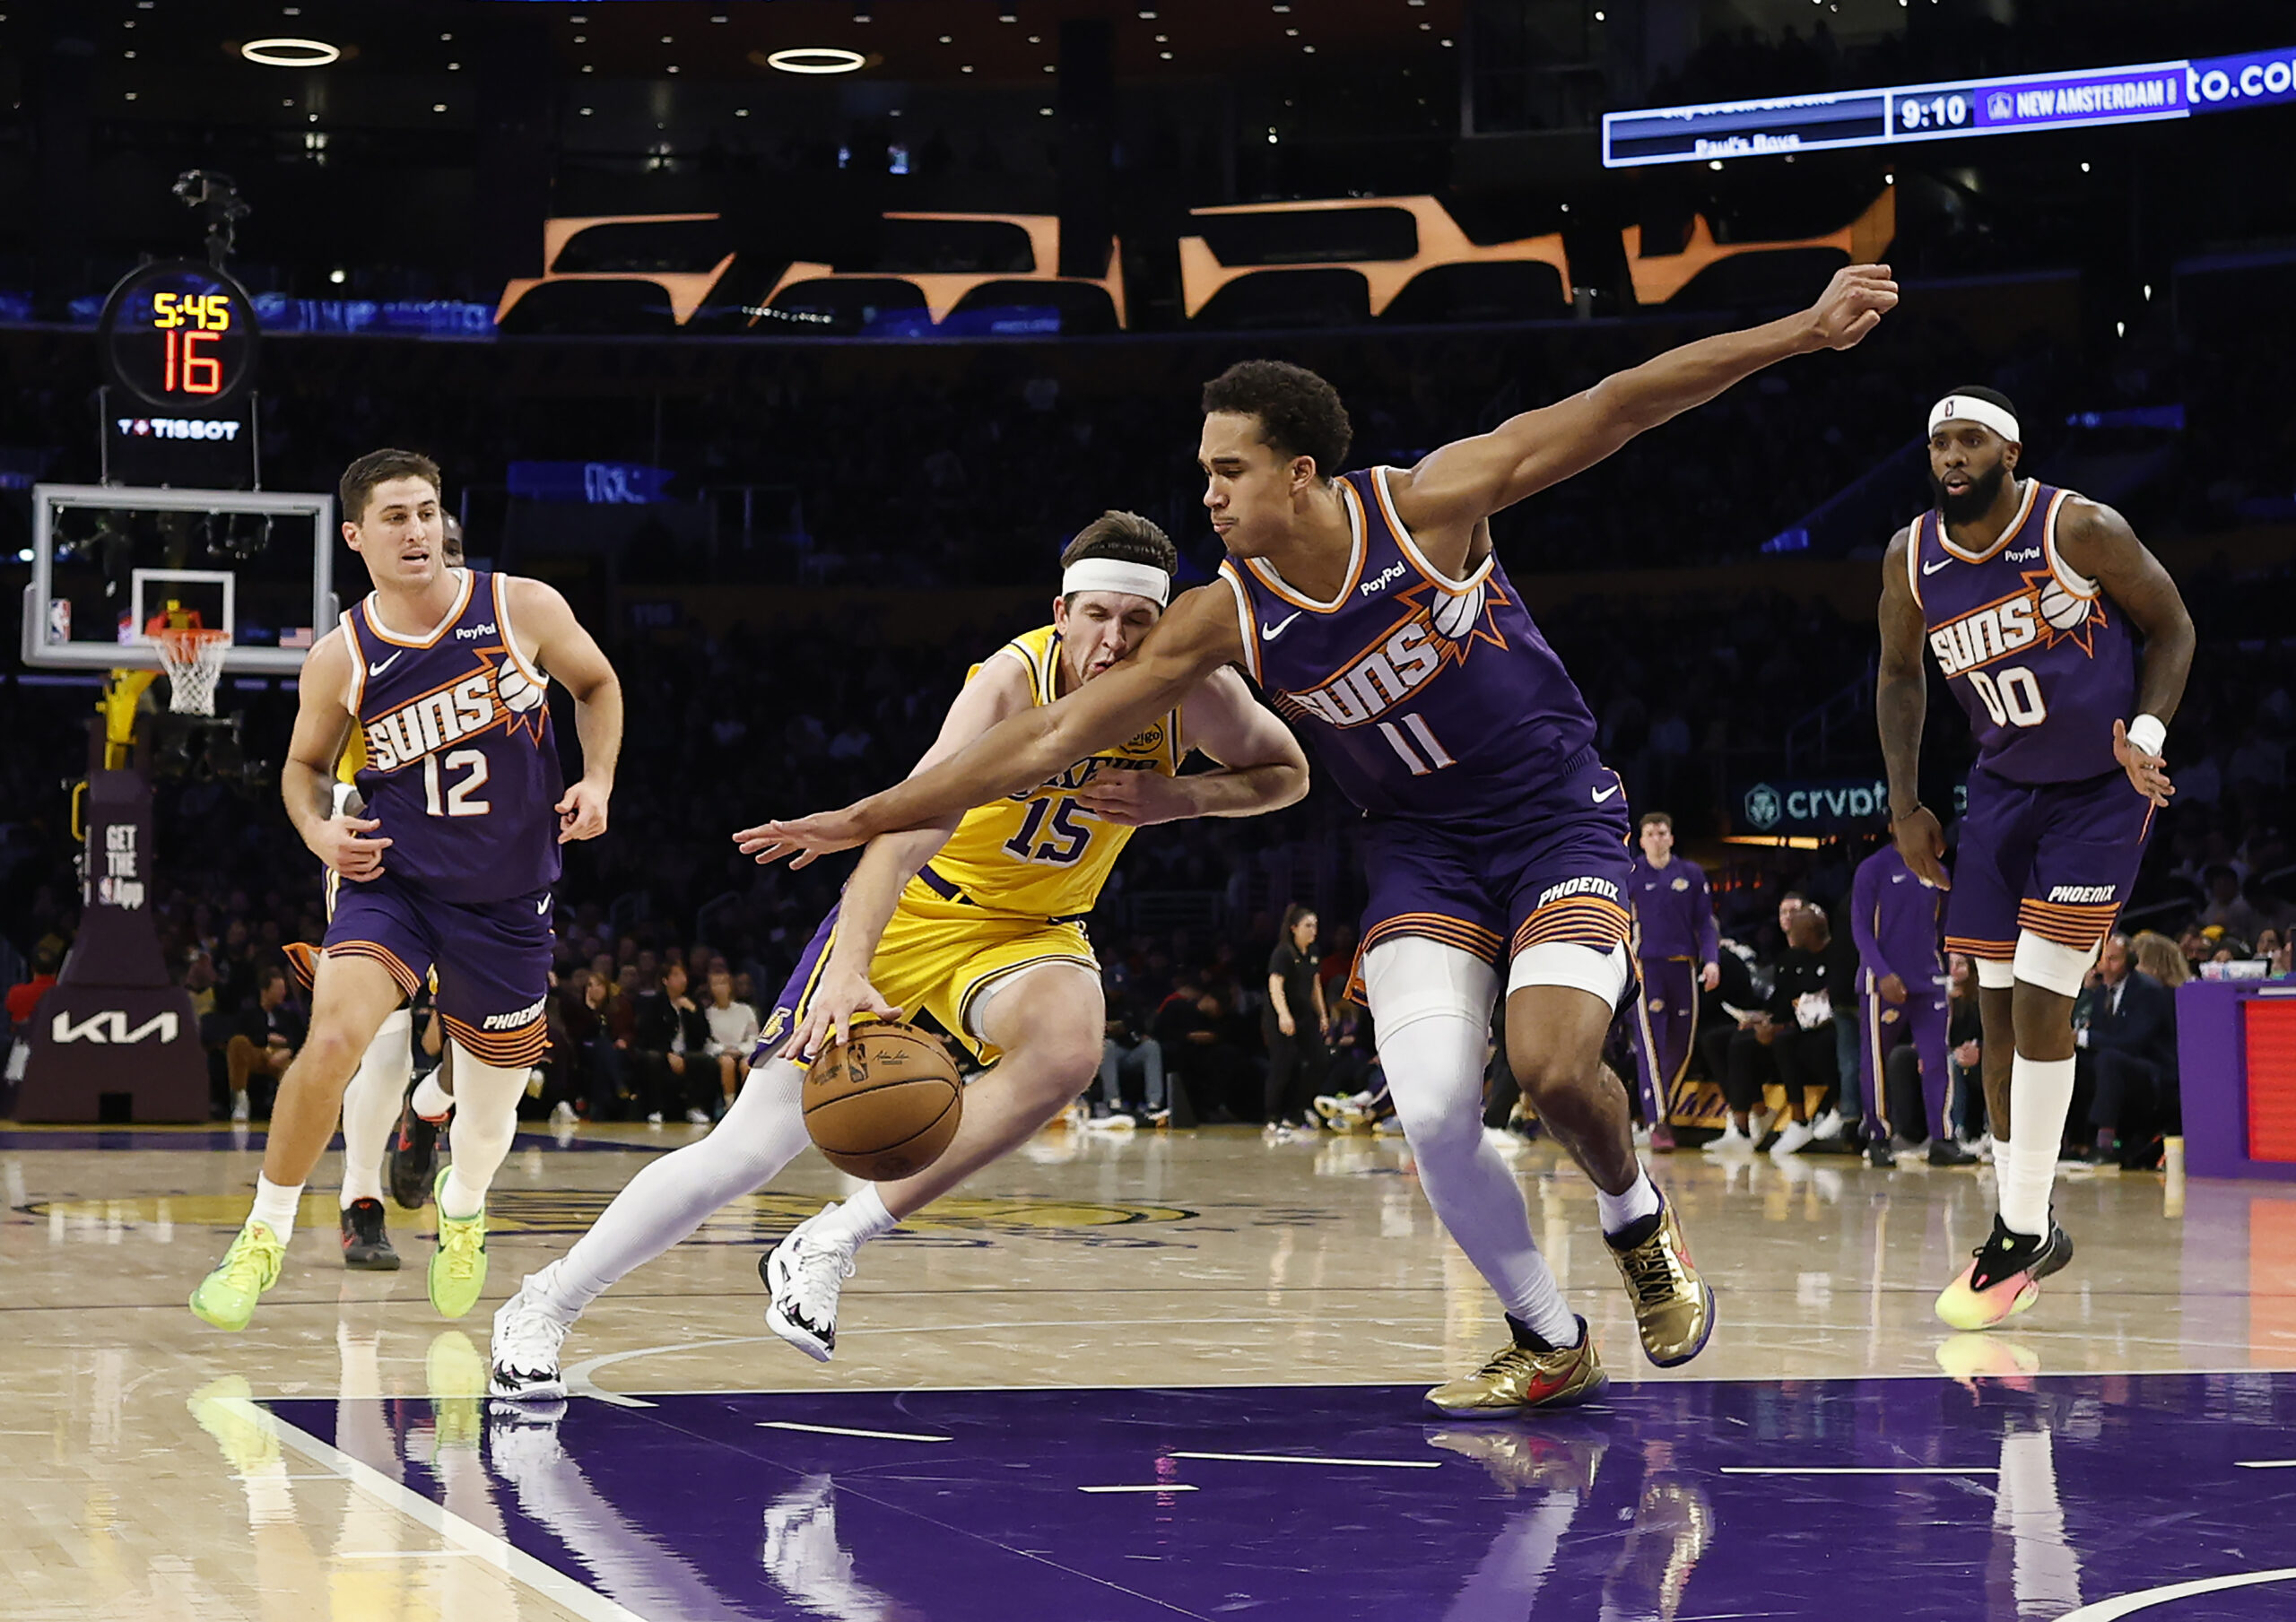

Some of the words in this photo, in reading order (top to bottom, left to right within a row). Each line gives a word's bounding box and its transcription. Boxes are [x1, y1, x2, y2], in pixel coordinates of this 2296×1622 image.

[1901, 94, 1966, 129] 9:10
[2016, 91, 2055, 118] NEW
[2055, 78, 2164, 114] AMSTERDAM
[153, 292, 230, 331] 5:45
[165, 329, 223, 395] 16
[150, 418, 241, 441] TISSOT
[2005, 545, 2040, 564] PayPal
[1360, 560, 1407, 597] PayPal
[456, 622, 497, 641] PayPal
[1929, 594, 2038, 677] SUNS
[1967, 665, 2048, 728] 00
[366, 674, 494, 772] SUNS
[1377, 712, 1459, 776] 11
[424, 749, 491, 817] 12
[1787, 780, 1888, 820] crypt
[106, 824, 137, 851] GET
[1001, 795, 1103, 869] 15
[106, 851, 137, 878] THE
[1536, 876, 1620, 909] PHOENIX
[2048, 884, 2117, 903] PHOENIX
